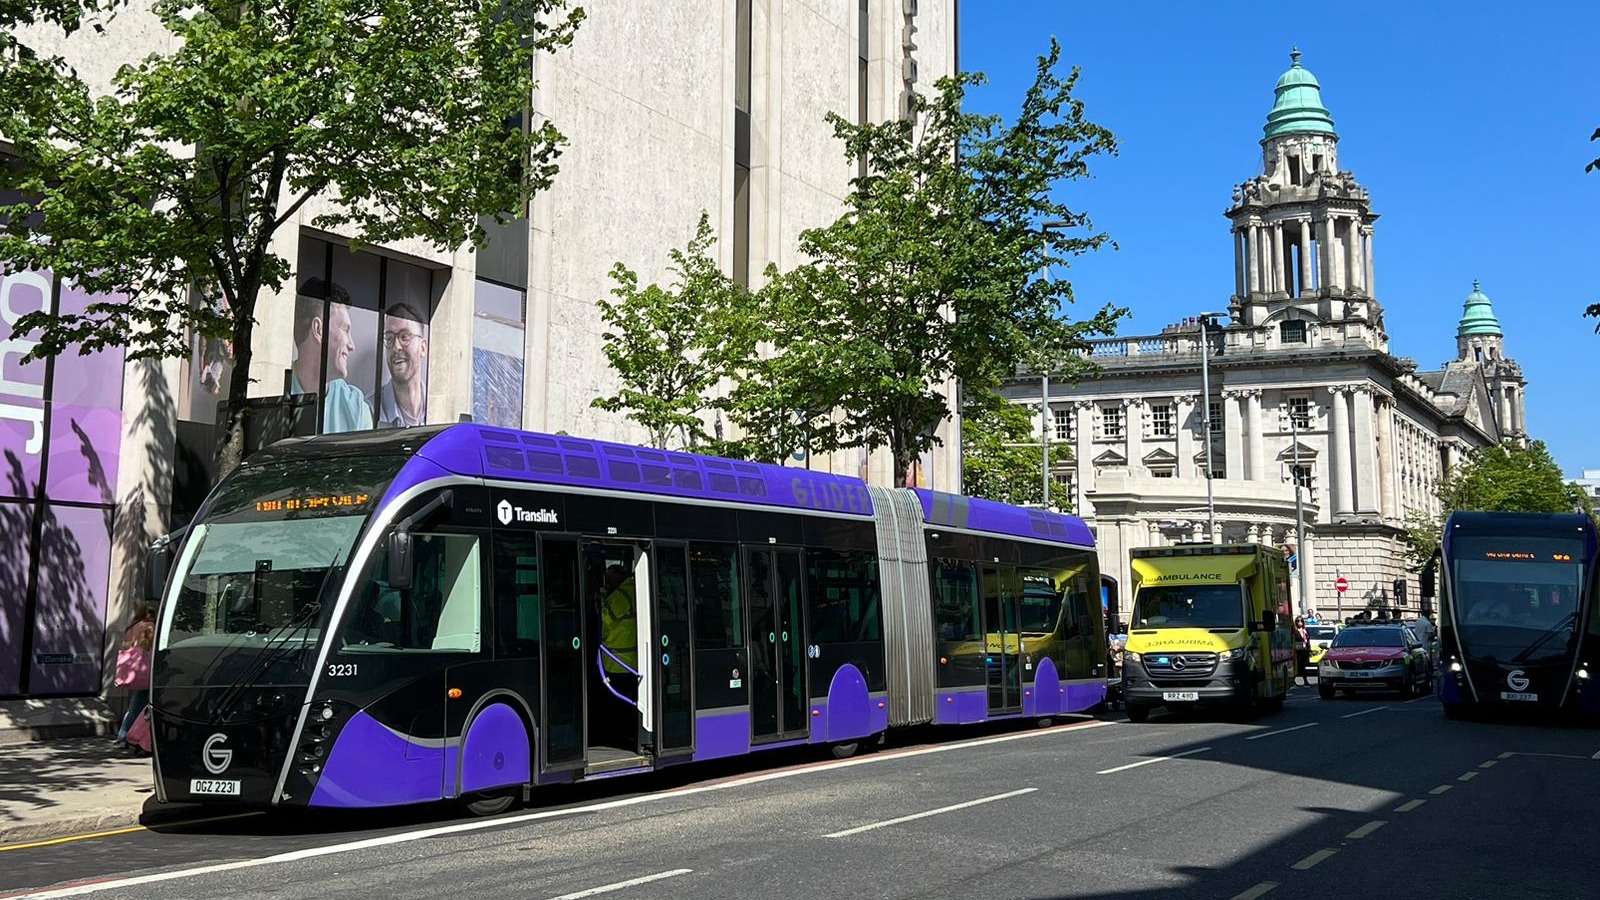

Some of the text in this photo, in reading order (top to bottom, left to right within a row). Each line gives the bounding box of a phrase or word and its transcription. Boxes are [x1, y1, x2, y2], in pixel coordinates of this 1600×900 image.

[514, 506, 558, 523] Translink
[1156, 573, 1222, 582] AMBULANCE
[328, 664, 358, 677] 3231
[202, 732, 233, 775] G
[195, 780, 236, 794] OGZ 2231
